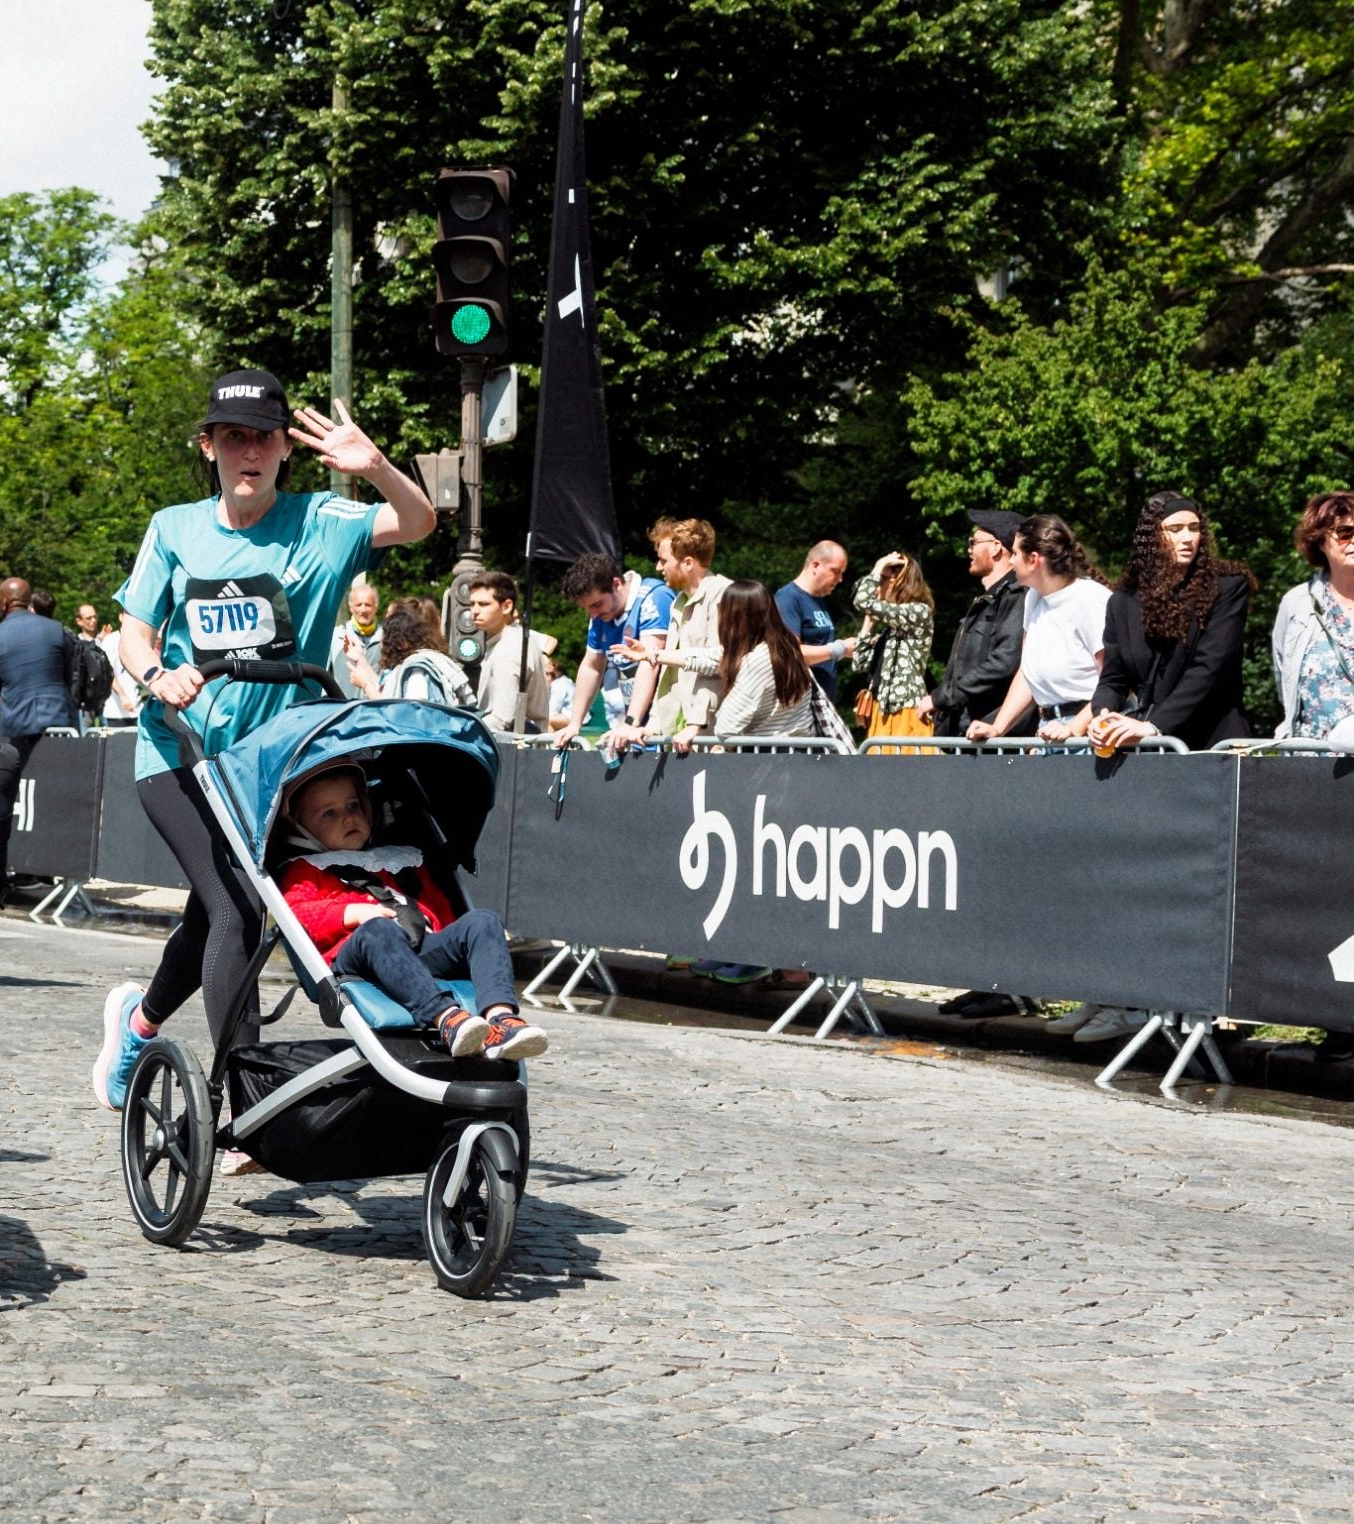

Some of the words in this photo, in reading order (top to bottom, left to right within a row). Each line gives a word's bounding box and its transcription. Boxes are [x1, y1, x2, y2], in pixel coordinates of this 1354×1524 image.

[217, 385, 261, 400] THULE
[197, 602, 259, 634] 57119
[752, 795, 958, 933] happn
